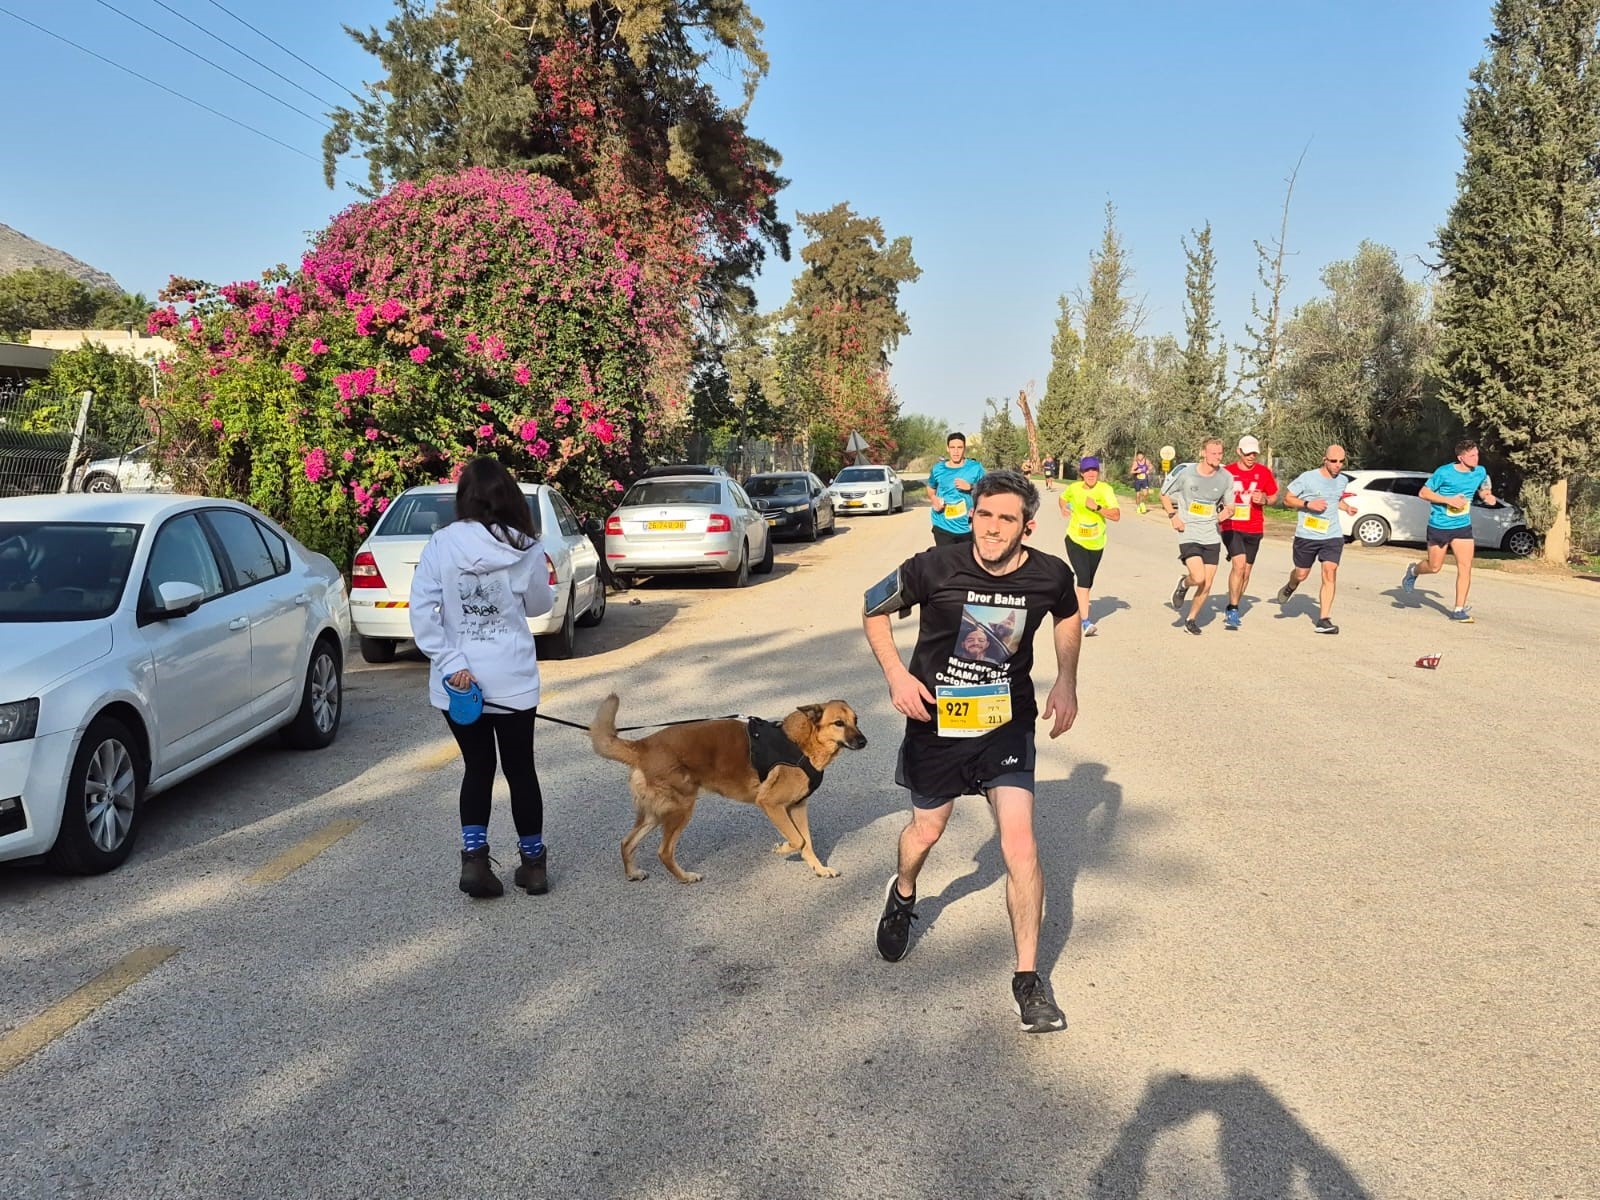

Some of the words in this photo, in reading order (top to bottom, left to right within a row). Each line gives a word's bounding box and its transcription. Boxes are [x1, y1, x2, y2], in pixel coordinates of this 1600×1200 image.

[967, 591, 992, 603] Dror
[994, 594, 1026, 606] Bahat
[948, 657, 992, 673] Murdere
[947, 666, 985, 681] HAMA
[946, 702, 969, 716] 927
